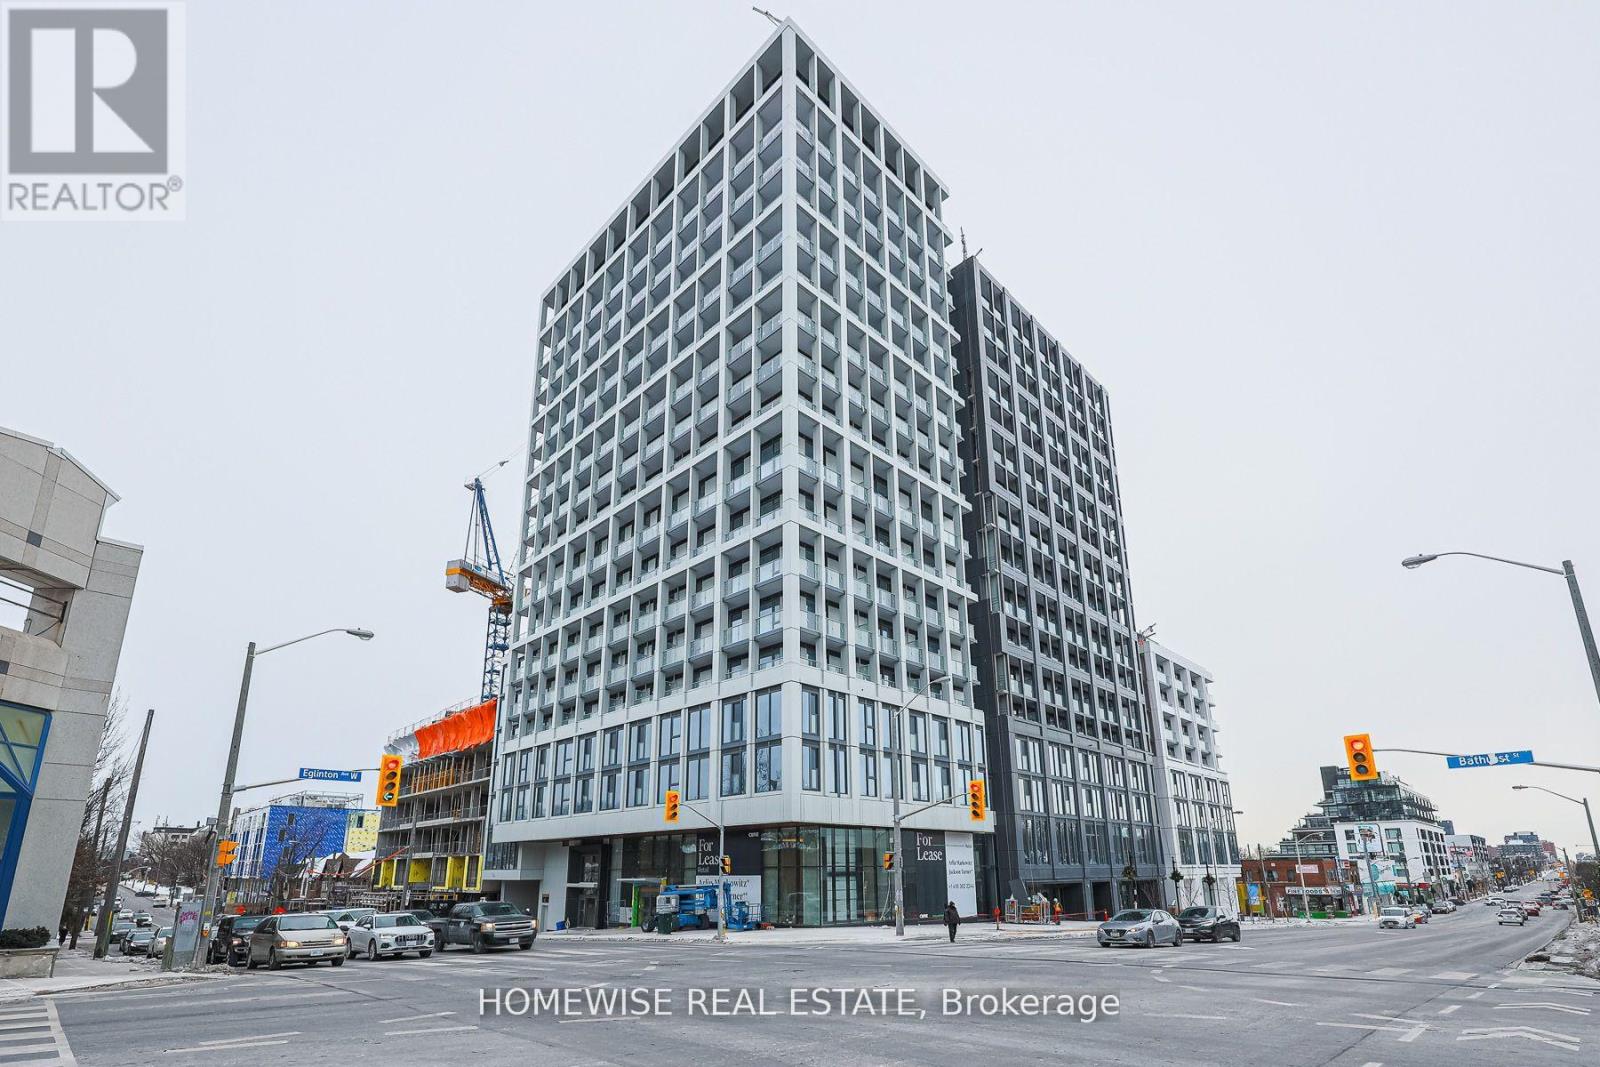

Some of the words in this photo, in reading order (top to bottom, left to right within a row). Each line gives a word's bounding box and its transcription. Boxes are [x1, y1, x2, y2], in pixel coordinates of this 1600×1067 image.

[303, 769, 339, 779] Eglinton
[350, 772, 359, 780] W
[698, 839, 714, 852] For
[916, 831, 933, 847] For
[917, 846, 943, 861] Lease
